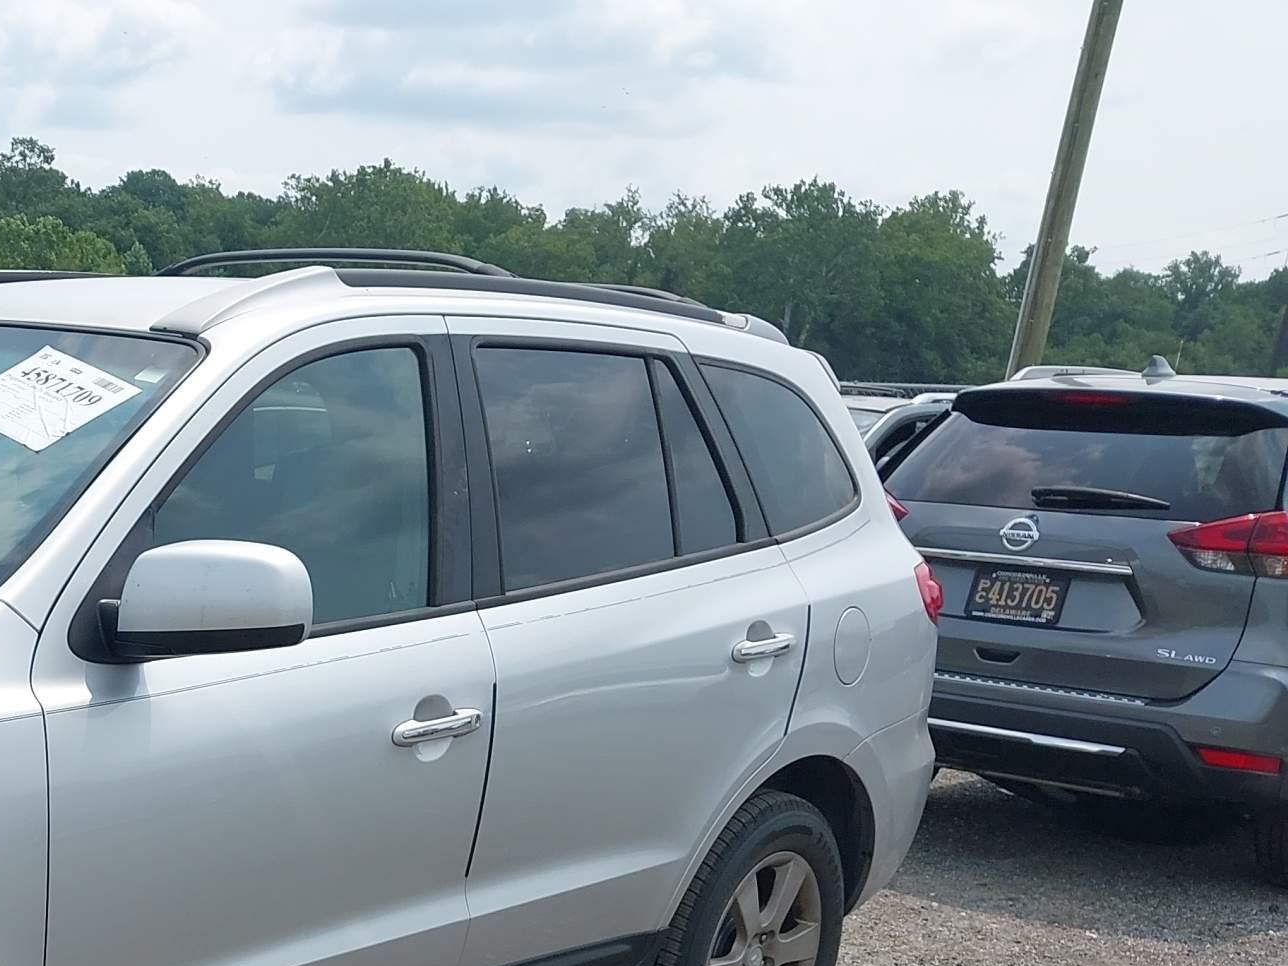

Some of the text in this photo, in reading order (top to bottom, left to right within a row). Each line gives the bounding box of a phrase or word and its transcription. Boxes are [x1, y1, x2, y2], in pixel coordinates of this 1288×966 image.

[20, 366, 103, 407] 45871709
[988, 581, 1060, 610] 413705
[1157, 648, 1217, 664] SL AWD
